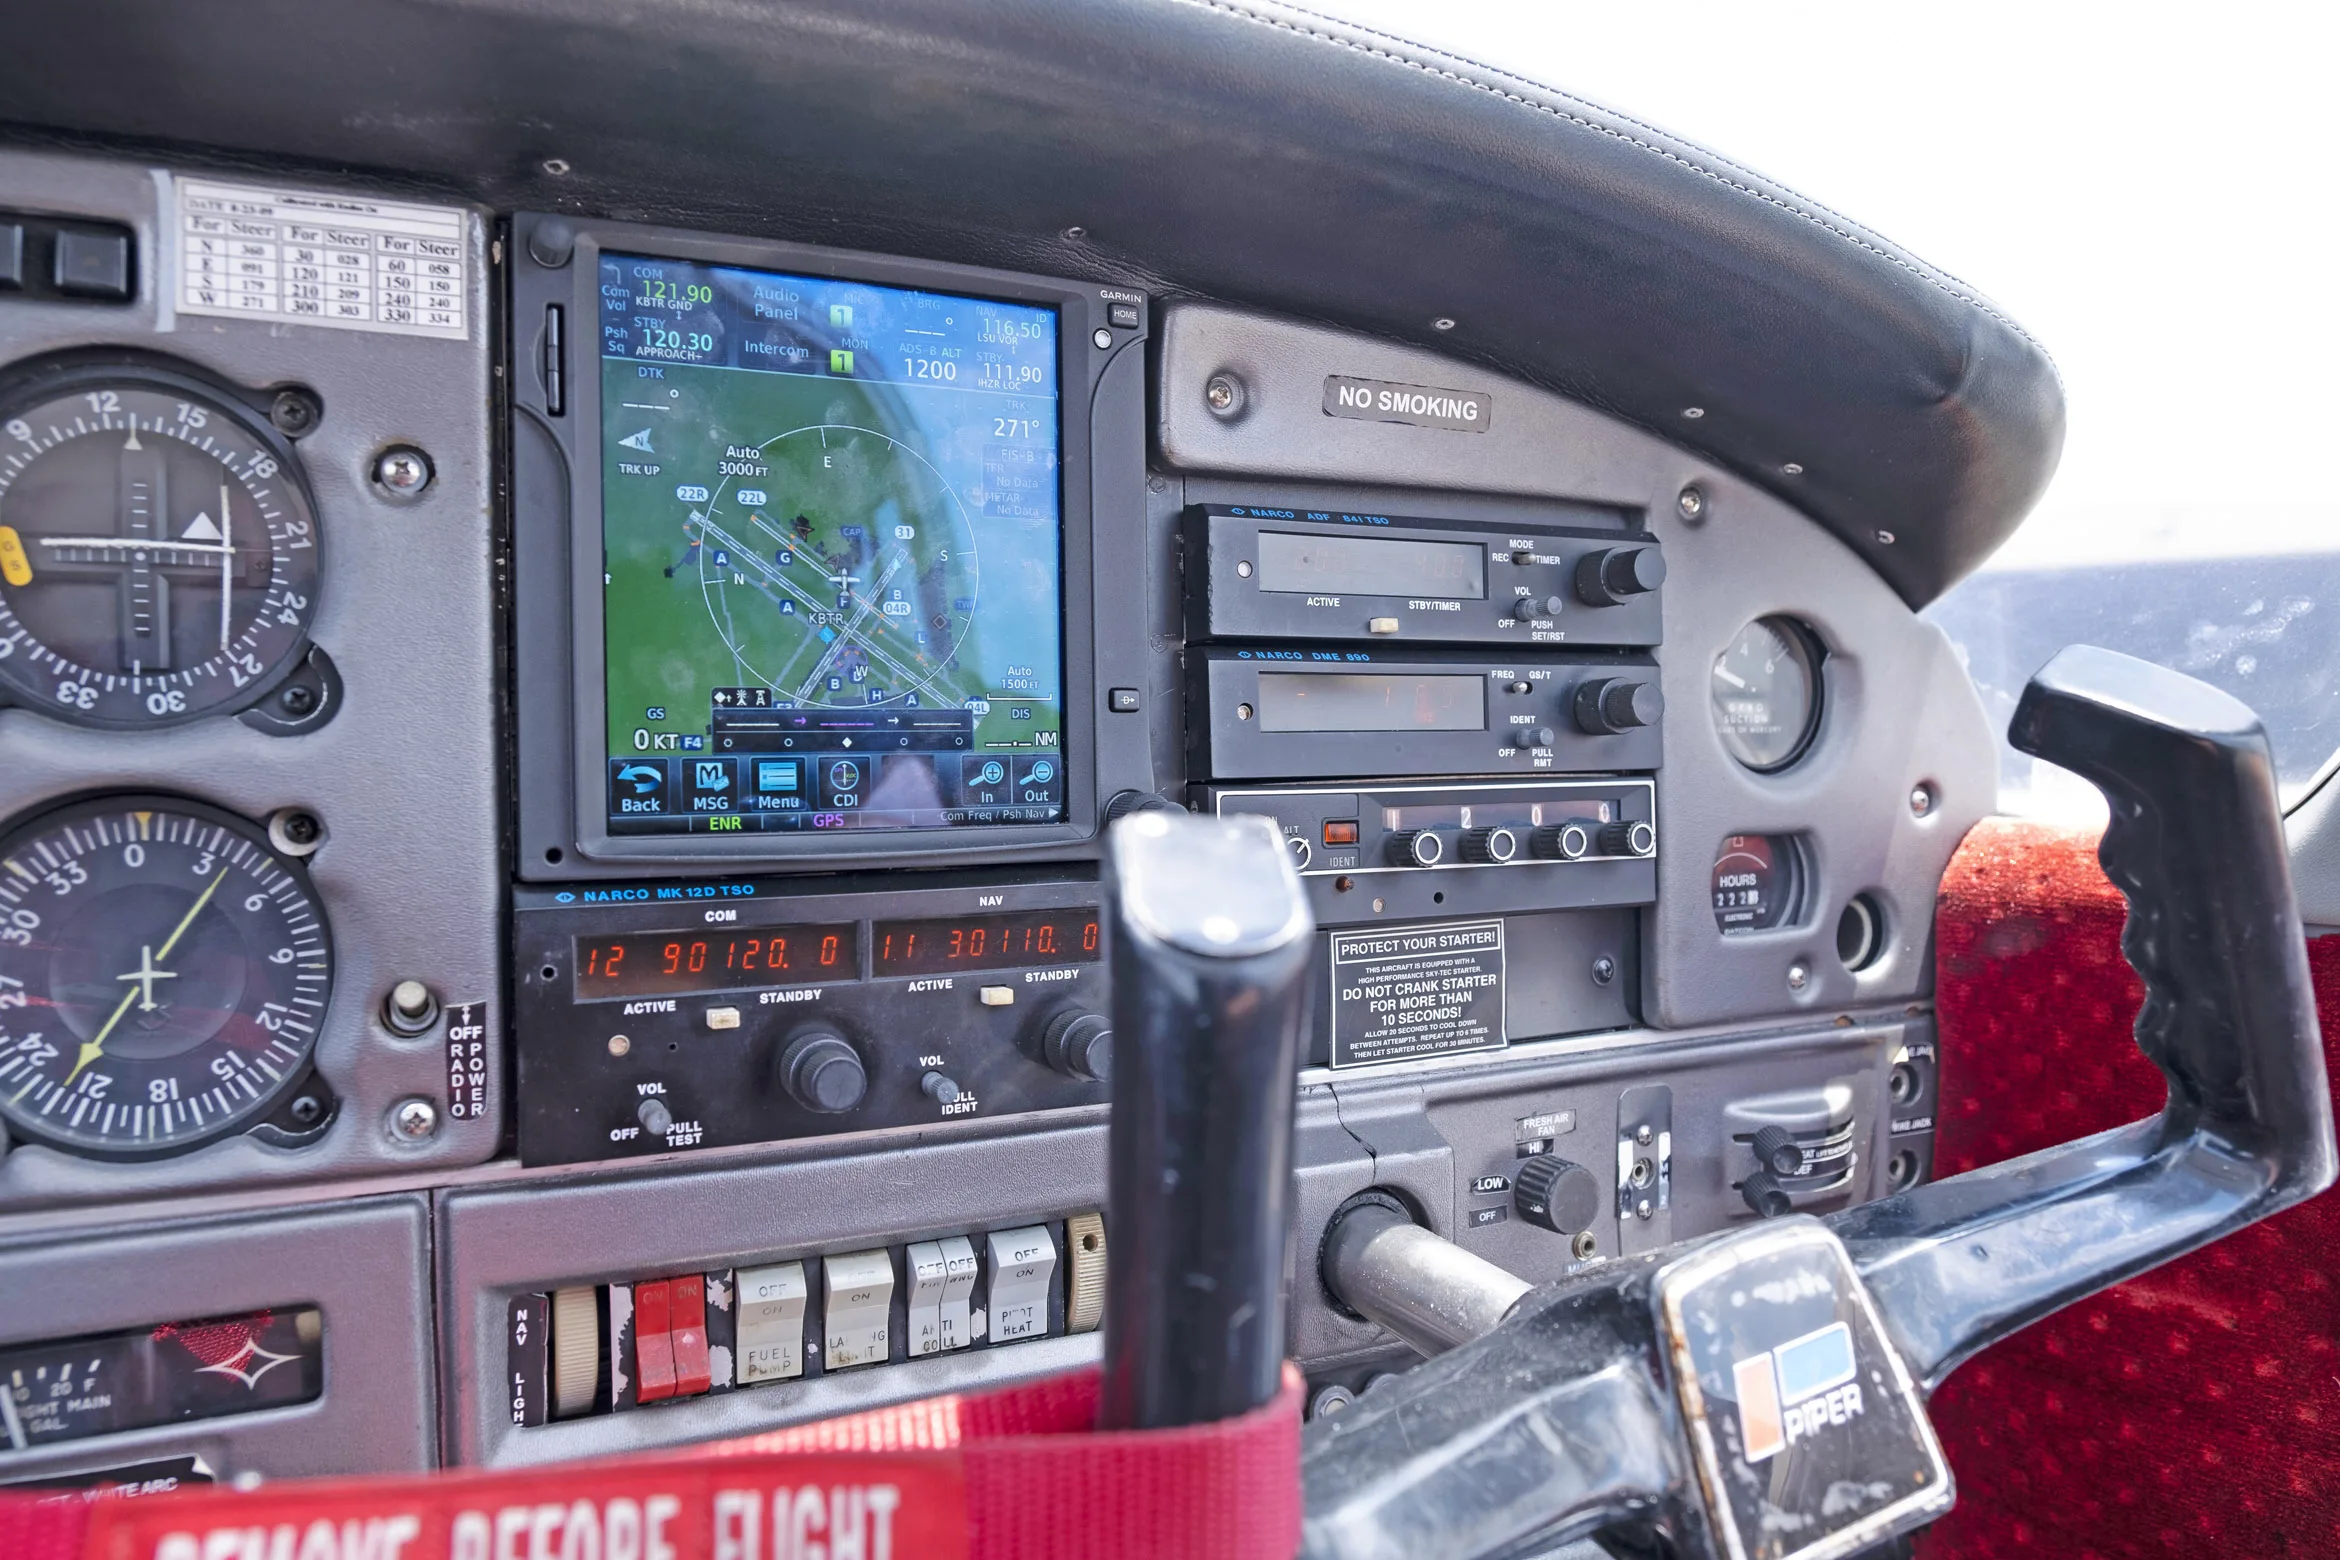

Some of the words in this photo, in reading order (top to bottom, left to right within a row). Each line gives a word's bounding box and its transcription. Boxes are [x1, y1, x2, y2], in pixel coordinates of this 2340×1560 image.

[290, 225, 318, 240] For
[327, 230, 368, 246] Steer
[383, 235, 410, 251] For
[418, 239, 458, 256] Steer
[388, 259, 406, 272] 60
[293, 267, 318, 280] 120
[386, 276, 410, 289] 150
[429, 281, 450, 292] 150
[633, 267, 663, 280] COM
[292, 283, 319, 297] 210
[385, 293, 411, 306] 240
[602, 285, 630, 298] Com
[642, 279, 712, 303] 121.90
[753, 286, 799, 303] Audio
[1100, 290, 1142, 304] GARMIN
[606, 299, 626, 312] Vol
[635, 296, 665, 308] KBTR
[667, 299, 693, 311] GND
[291, 300, 319, 313] 300
[385, 308, 411, 322] 330
[755, 304, 798, 321] Panel
[1113, 309, 1137, 320] HOME
[634, 316, 666, 329] STBY
[982, 318, 1041, 339] 116.50
[605, 326, 628, 339] Psh
[608, 341, 625, 354] Sq
[642, 329, 713, 352] 120.30
[841, 337, 869, 350] MON
[745, 340, 809, 358] Intercom
[638, 367, 665, 380] DTK
[903, 358, 957, 381] 1200
[982, 362, 1042, 383] 111.90
[86, 391, 121, 414] 12
[1339, 385, 1372, 409] NO
[1378, 390, 1478, 421] SMOKING
[177, 402, 209, 429] 15
[6, 419, 34, 441] 9
[726, 445, 760, 459] Auto
[247, 449, 279, 479] 18
[618, 463, 641, 475] TRK
[643, 465, 661, 476] UP
[718, 462, 754, 476] 3000
[1250, 508, 1295, 519] NARCO
[1307, 512, 1330, 521] ADF
[285, 520, 313, 549] 21
[1509, 539, 1534, 549] MODE
[1492, 553, 1509, 562] REC
[1535, 555, 1560, 565] TIMER
[1514, 587, 1531, 596] VOL
[1306, 597, 1340, 607] ACTIVE
[1408, 600, 1461, 612] STBY/TIMER
[808, 613, 845, 625] KBTR
[1498, 619, 1515, 628] OFF
[1531, 620, 1553, 629] PUSH
[1532, 632, 1565, 641] SET/RST
[1255, 651, 1303, 660] NARCO
[1312, 652, 1341, 661] DME
[1008, 666, 1032, 677] Auto
[1491, 670, 1515, 680] FREQ
[1529, 671, 1552, 680] GS/T
[56, 680, 99, 710] 33
[146, 690, 187, 716] 30
[647, 708, 665, 719] GS
[1011, 708, 1030, 720] DIS
[1510, 716, 1536, 724] IDENT
[654, 734, 679, 750] KT
[1035, 732, 1057, 746] NM
[1498, 749, 1516, 757] OFF
[1532, 749, 1553, 757] PULL
[1534, 759, 1552, 767] RMT
[758, 796, 800, 809] Menu
[833, 794, 858, 807] CDI
[981, 791, 993, 803] In
[1024, 789, 1049, 802] Out
[621, 798, 661, 812] Back
[693, 797, 729, 810] MSG
[709, 816, 742, 830] ENR
[813, 814, 845, 827] GPS
[940, 811, 964, 822] Com
[968, 810, 992, 822] Freq
[123, 843, 145, 868] 0
[1329, 856, 1356, 867] IDENT
[191, 853, 217, 876] 3
[45, 860, 88, 896] 33
[1719, 873, 1757, 888] HOURS
[584, 888, 649, 903] NARCO
[720, 885, 755, 897] TSO
[979, 895, 1003, 907] NAV
[244, 893, 270, 912] 6
[705, 910, 736, 923] COM
[1341, 941, 1400, 955] PROTECT
[1403, 937, 1436, 950] YOUR
[1440, 931, 1496, 947] STARTER!
[1366, 966, 1380, 974] THIS
[1382, 963, 1413, 972] AIRCRAFT
[1422, 959, 1453, 968] EQUIPPED
[1025, 969, 1079, 983] STANDBY
[1376, 972, 1424, 982] PERFORMANCE
[1425, 968, 1452, 978] SKY-TEC
[908, 979, 953, 992] ACTIVE
[1343, 988, 1362, 1001] DO
[1365, 985, 1392, 999] NOT
[1395, 980, 1439, 995] CRANK
[1442, 974, 1497, 990] STARTER
[759, 988, 822, 1005] STANDBY
[1370, 1000, 1397, 1013] FOR
[1400, 996, 1436, 1009] MORE
[1439, 991, 1472, 1004] THAN
[623, 1000, 676, 1015] ACTIVE
[255, 1002, 290, 1031] 12
[1381, 1014, 1395, 1026] 10
[1398, 1006, 1461, 1023] SECONDS!
[449, 1026, 483, 1040] OFF
[1365, 1029, 1388, 1038] ALLOW
[1397, 1024, 1428, 1034] SECONDS
[1350, 1041, 1382, 1050] BETWEEN
[1420, 1032, 1444, 1041] REPEAT
[1354, 1051, 1372, 1059] THEN
[1386, 1046, 1415, 1055] STARTER
[1416, 1043, 1434, 1051] COOL
[211, 1049, 247, 1082] 15
[919, 1055, 944, 1067] VOL
[451, 1044, 466, 1117] RADIO
[468, 1043, 485, 1116] POWER
[636, 1082, 666, 1095] VOL
[941, 1102, 978, 1115] IDENT
[666, 1120, 702, 1135] PULL
[1524, 1116, 1552, 1130] FRESH
[1554, 1113, 1569, 1124] AIR
[610, 1127, 639, 1142] OFF
[1538, 1126, 1555, 1136] FAN
[666, 1132, 702, 1147] TEST
[1478, 1177, 1503, 1191] LOW
[1479, 1211, 1496, 1222] OFF
[1015, 1248, 1039, 1261] OFF
[1016, 1268, 1034, 1277] ON
[758, 1283, 787, 1297] OFF
[763, 1305, 783, 1315] ON
[517, 1308, 528, 1346] NAV
[1003, 1320, 1033, 1336] HEAT
[749, 1347, 791, 1362] FUEL
[749, 1360, 792, 1375] PUMP
[67, 1394, 111, 1412] MAIN
[513, 1373, 525, 1427] LIGH
[1784, 1383, 1864, 1445] PIPER
[140, 1477, 178, 1493] ARC
